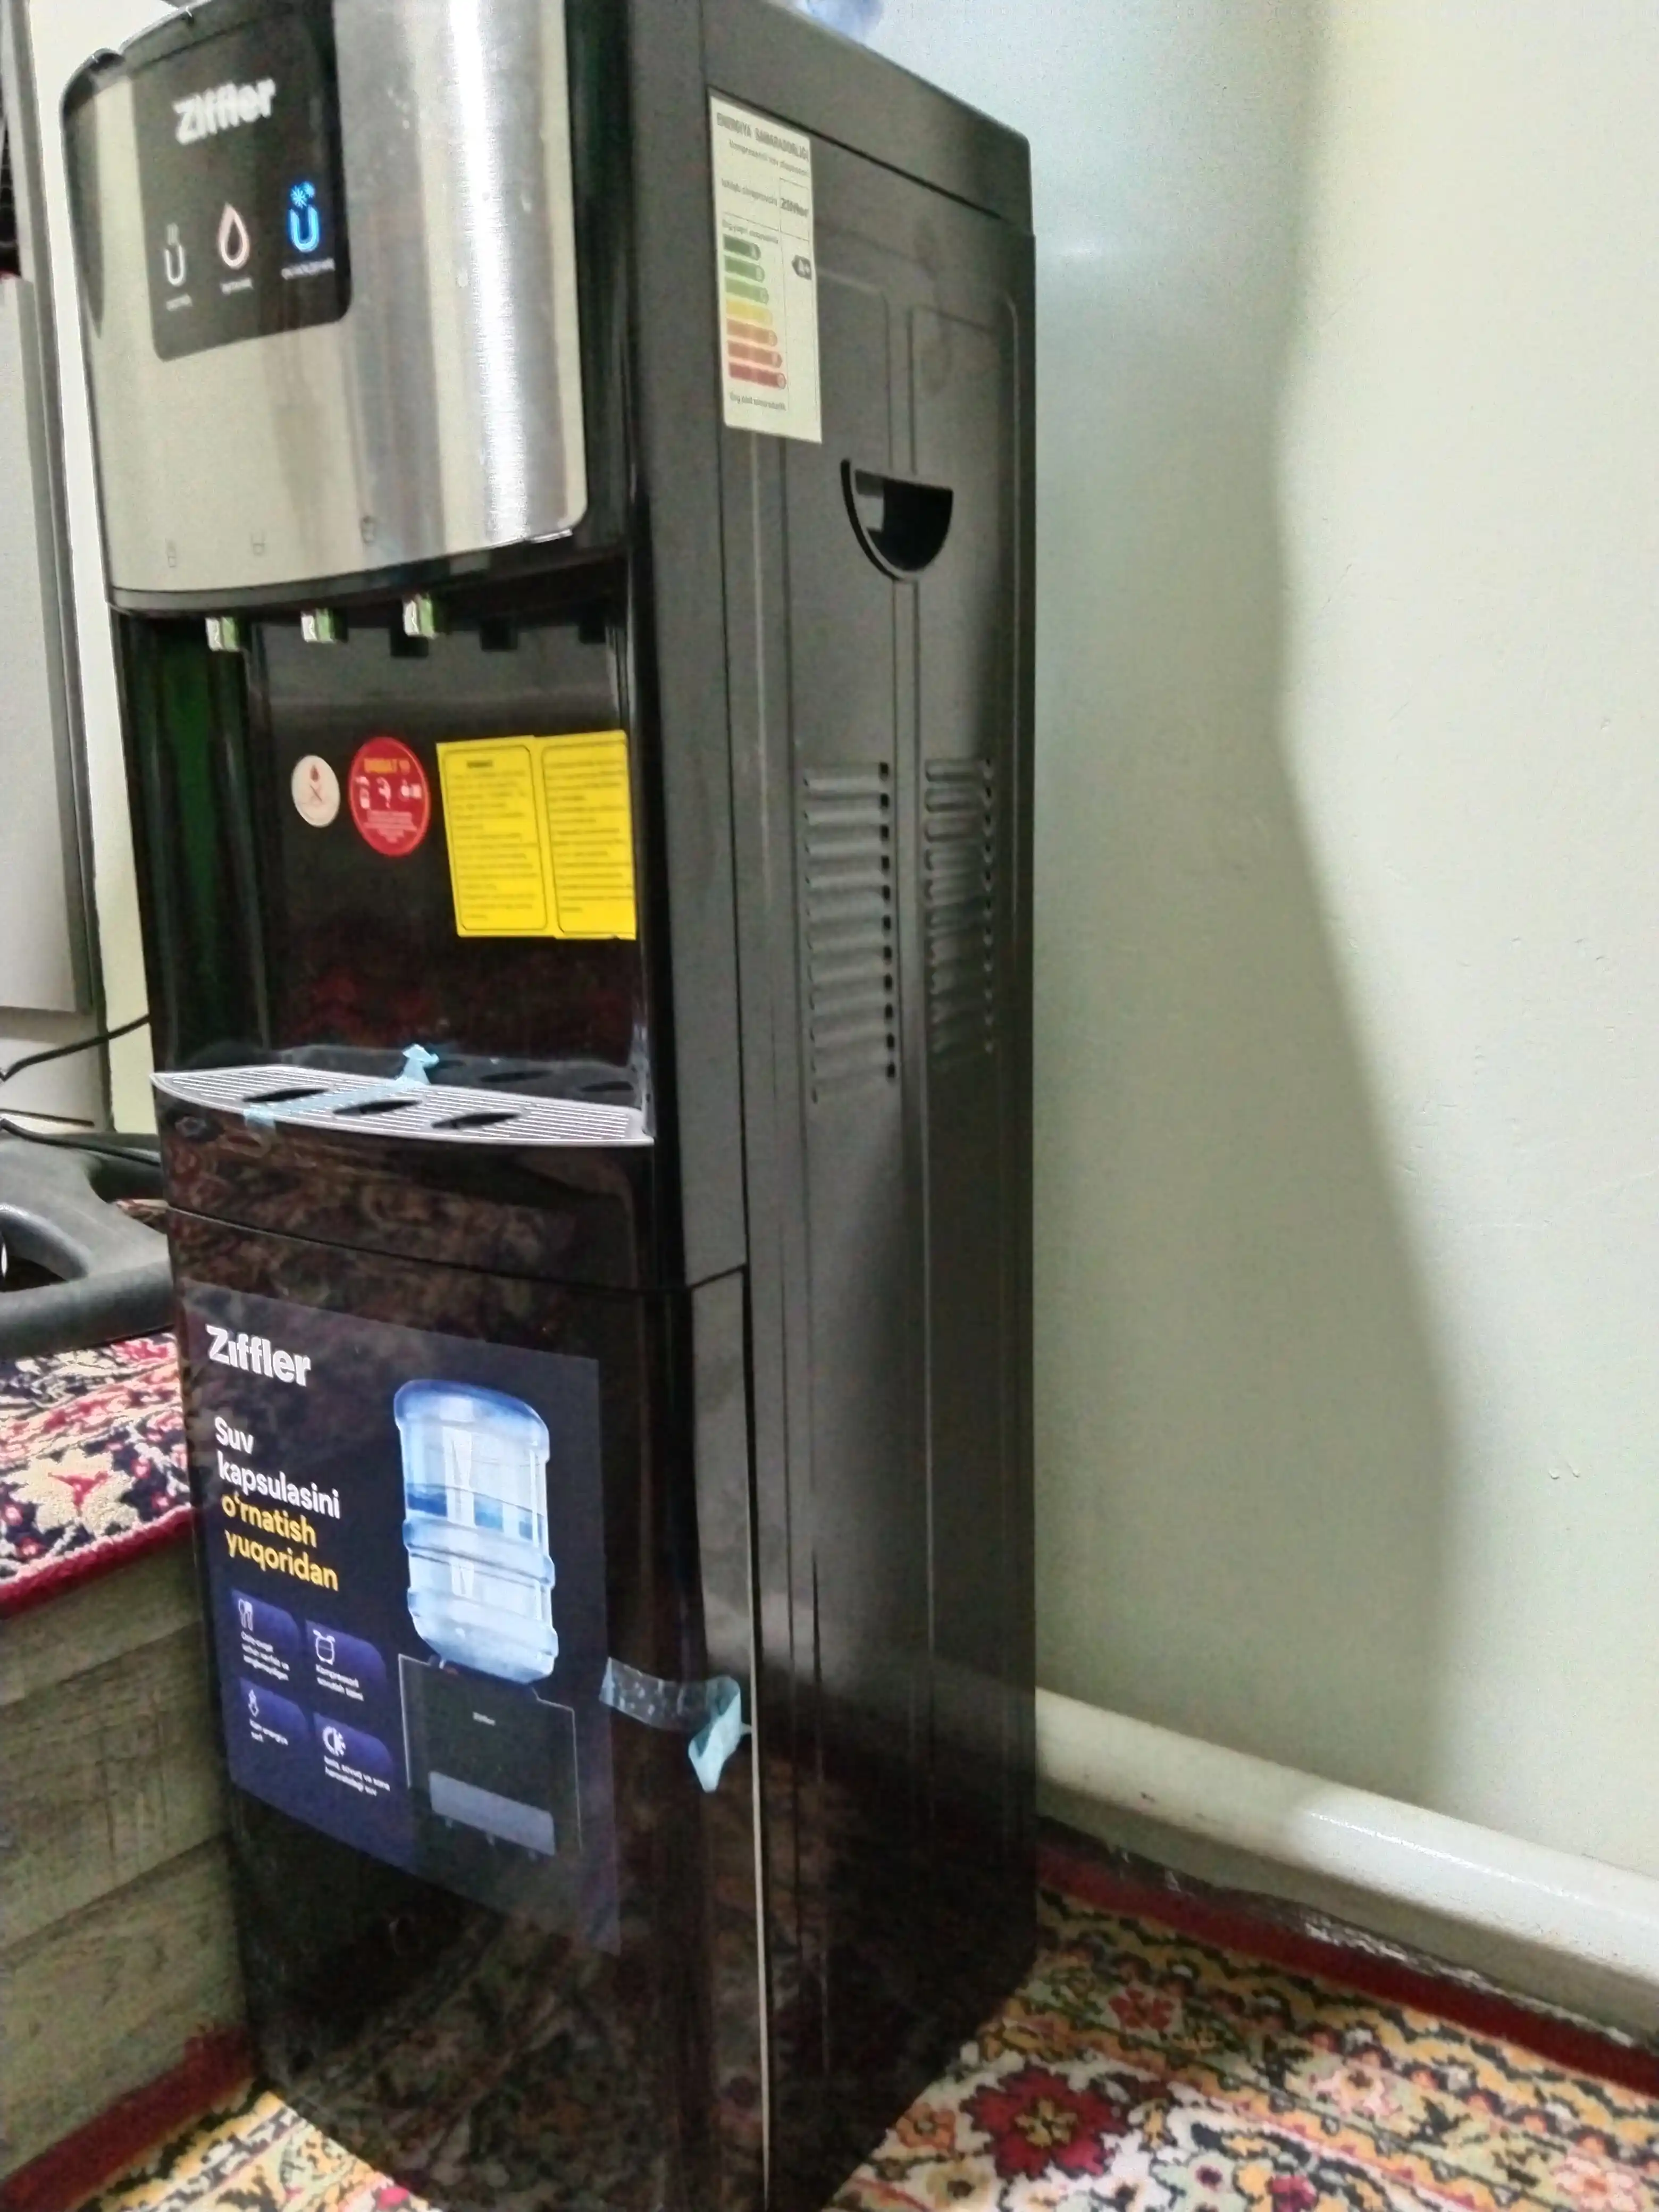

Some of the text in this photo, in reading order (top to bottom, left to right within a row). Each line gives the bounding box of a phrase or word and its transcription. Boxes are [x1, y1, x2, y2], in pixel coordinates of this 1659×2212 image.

[173, 78, 276, 145] Ziffler
[205, 1324, 312, 1387] Ziffler
[214, 1415, 254, 1454] Suv
[217, 1449, 340, 1519] kapsulasini
[224, 1529, 339, 1591] yuqoridan
